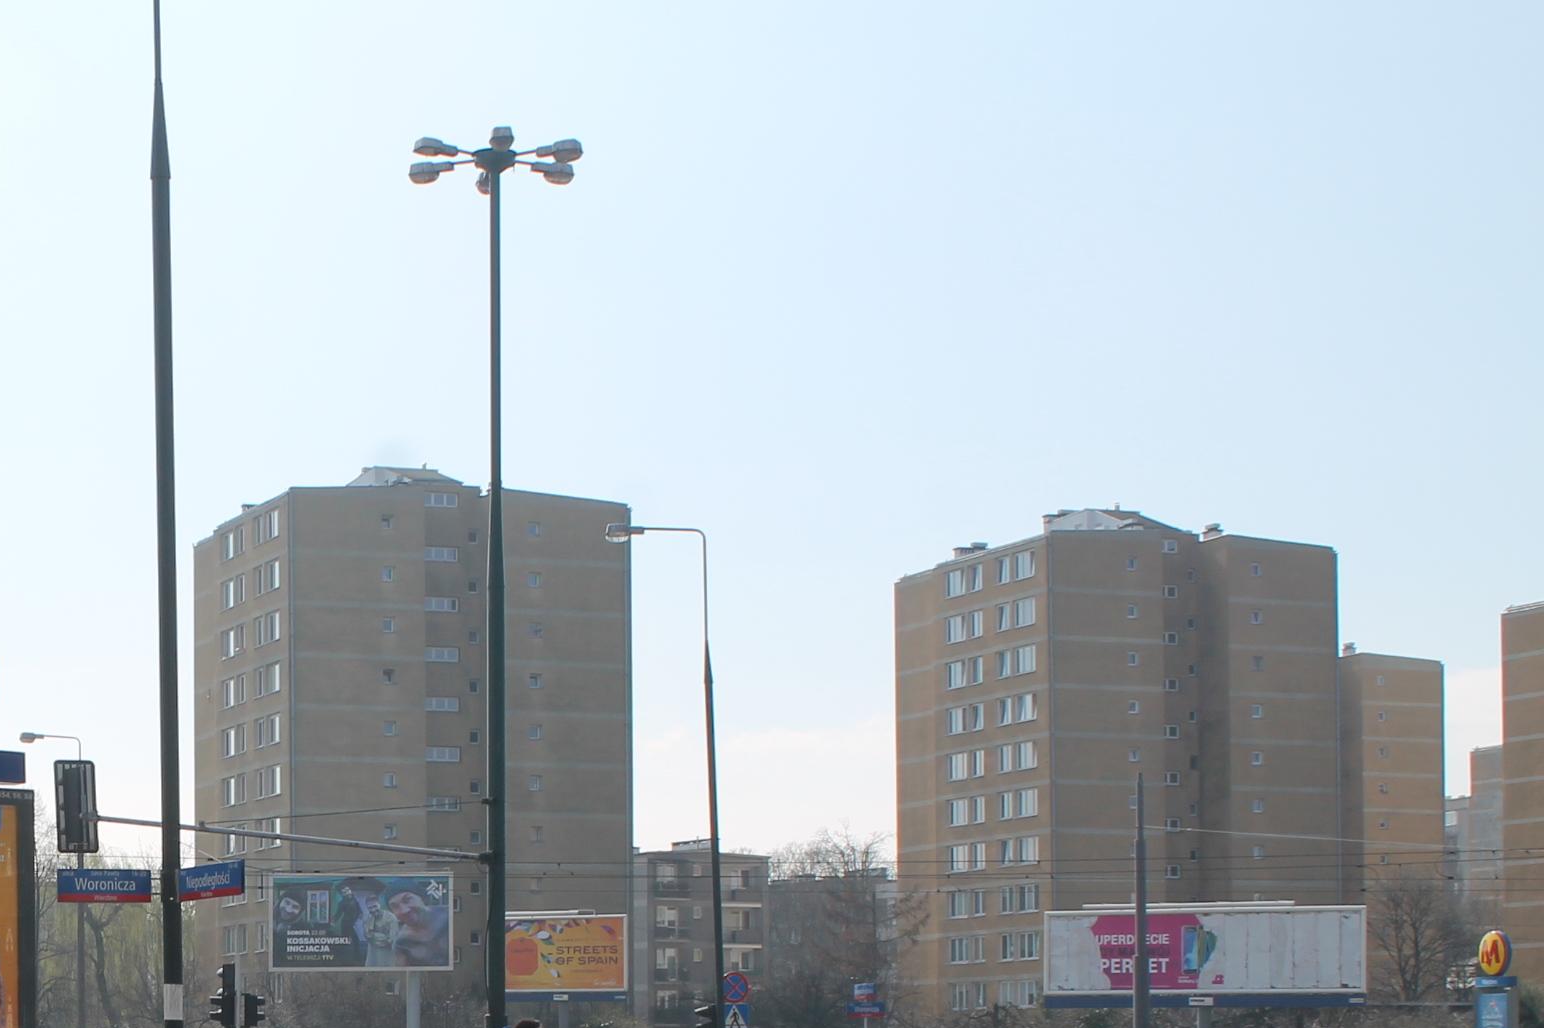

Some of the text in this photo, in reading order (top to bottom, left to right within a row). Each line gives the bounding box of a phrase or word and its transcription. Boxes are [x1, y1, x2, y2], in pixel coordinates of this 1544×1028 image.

[75, 878, 136, 891] Woronicza
[186, 870, 231, 891] Niepodległości
[286, 945, 330, 953] INICJACJA
[556, 945, 618, 955] STREETS
[556, 956, 618, 966] OF SPAIN
